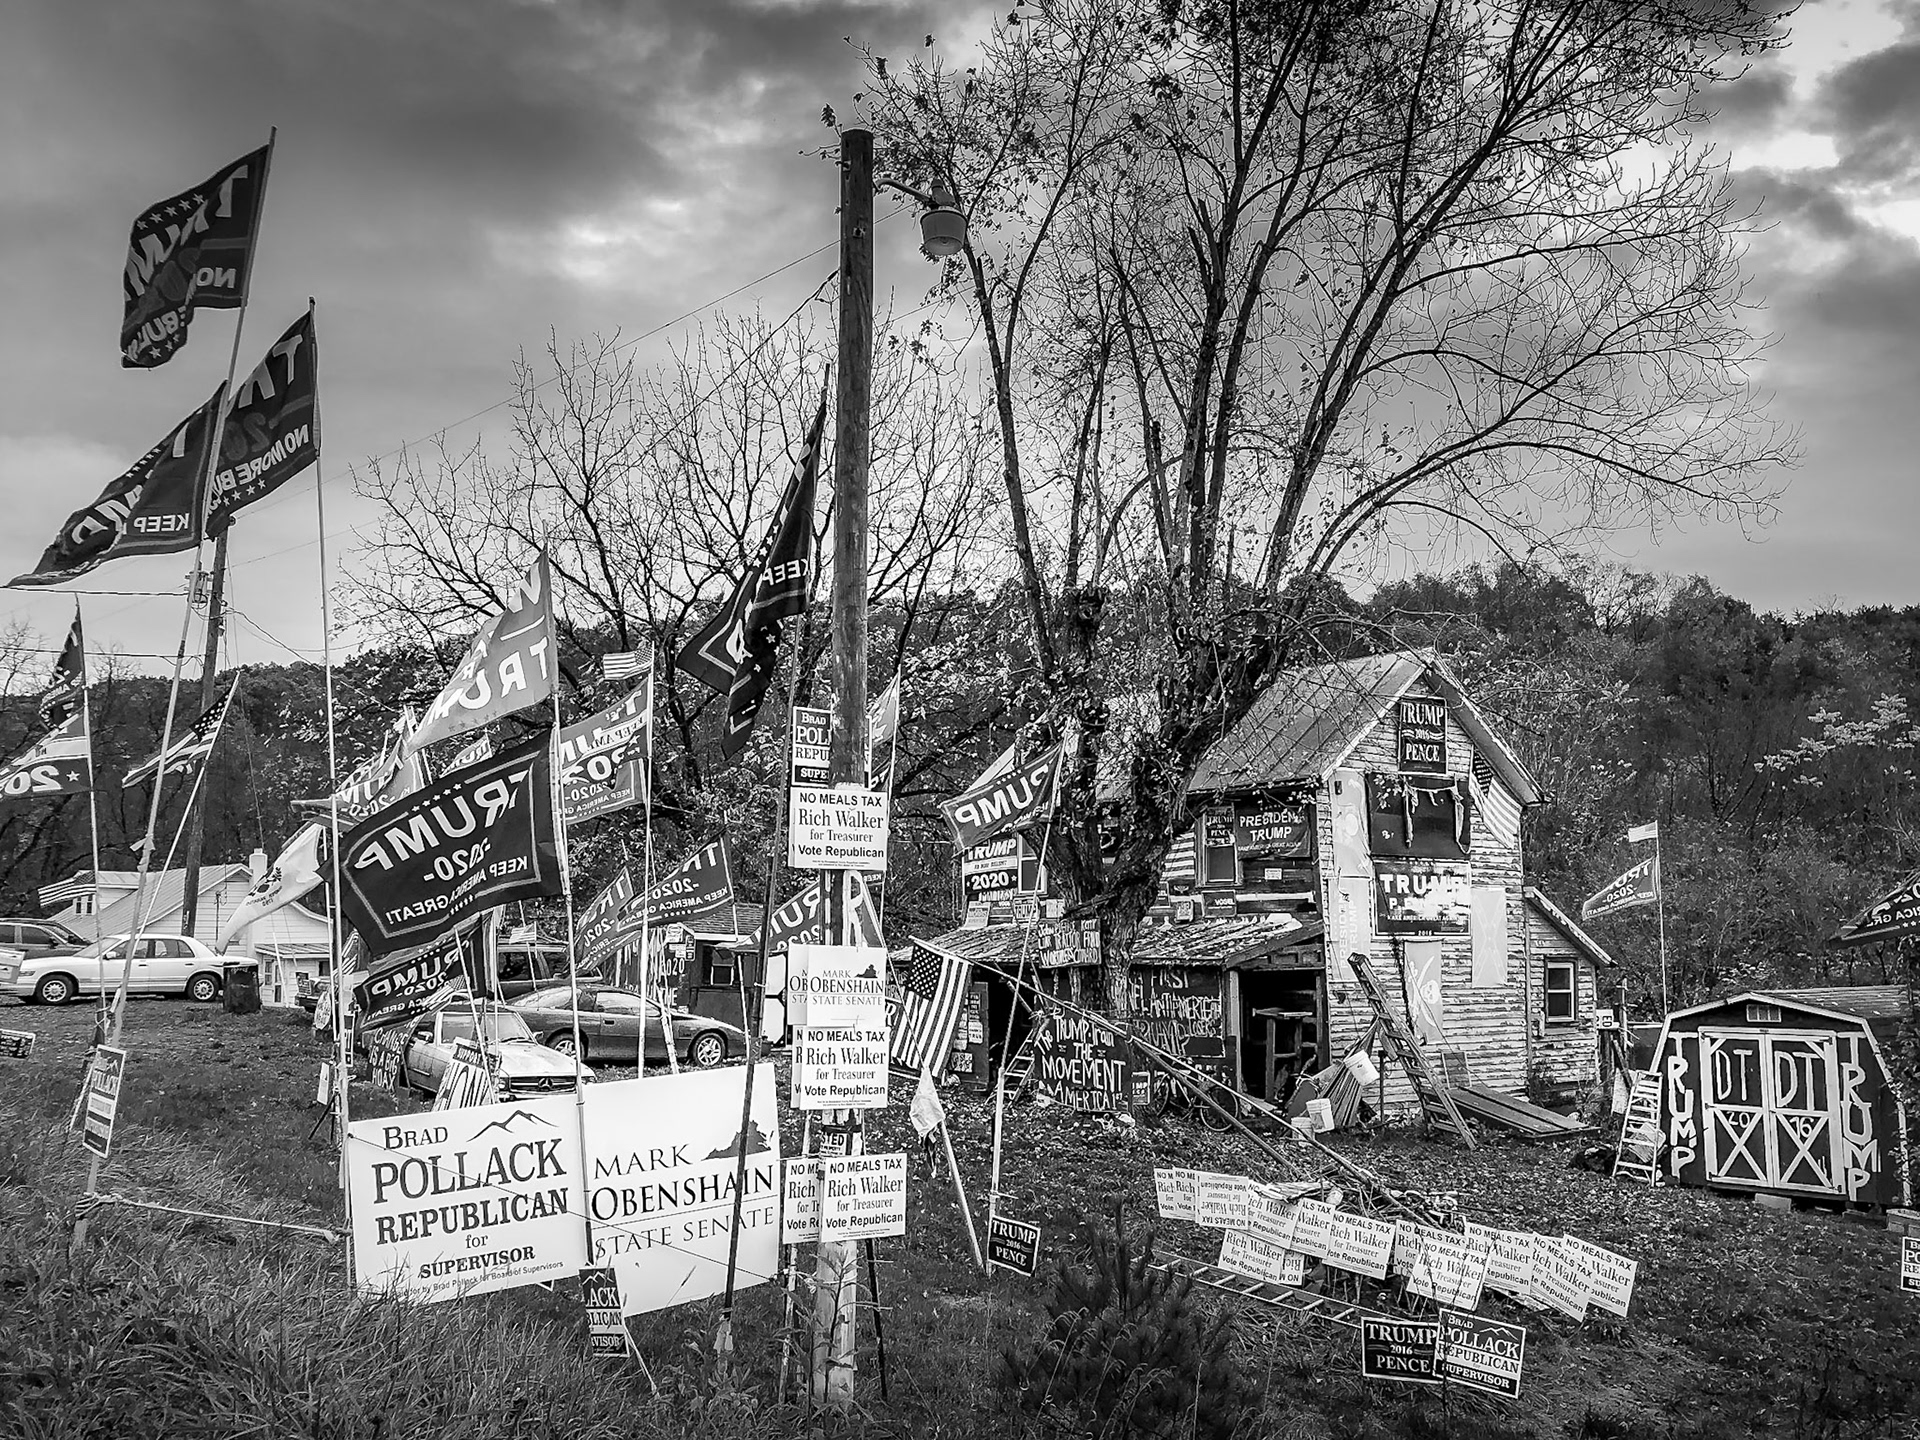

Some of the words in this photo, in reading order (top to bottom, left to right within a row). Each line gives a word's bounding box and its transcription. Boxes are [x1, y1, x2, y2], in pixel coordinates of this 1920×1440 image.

[1402, 702, 1444, 726] TRUMP
[1405, 743, 1440, 761] PENCE
[799, 793, 816, 803] NO
[819, 794, 858, 806] MEALS
[861, 796, 882, 807] TAX
[799, 808, 831, 826] Rich
[835, 810, 884, 828] Walker
[810, 829, 824, 840] for
[827, 830, 873, 842] Treasurer
[1250, 827, 1292, 841] TRUMP
[799, 845, 821, 855] Vote
[825, 846, 884, 858] Republican
[967, 838, 1017, 861] TRUMP
[971, 871, 1009, 890] 2020
[823, 970, 851, 979] MARK
[810, 976, 884, 994] OBENSHAIN
[813, 995, 841, 1005] STATE
[845, 995, 883, 1005] SENATE
[808, 1031, 823, 1042] NO
[827, 1031, 862, 1042] MEALS
[865, 1031, 885, 1042] TAX
[369, 1045, 379, 1067] IS
[378, 1051, 385, 1067] A
[384, 1052, 399, 1075] BIG
[806, 1047, 836, 1065] Rich
[841, 1047, 886, 1065] Walker
[1073, 1042, 1094, 1061] THE
[372, 1067, 396, 1093] HOAX
[816, 1067, 830, 1080] for
[833, 1068, 876, 1080] Treasurer
[1041, 1055, 1126, 1092] MOVEMENT
[1715, 1050, 1753, 1101] DT
[1775, 1051, 1821, 1112] DT
[805, 1083, 827, 1096] Vote
[831, 1083, 886, 1099] Republican
[1054, 1080, 1110, 1111] AMERICA
[1668, 1032, 1698, 1180] TRUMP
[1725, 1112, 1750, 1128] 20
[1836, 1032, 1881, 1202] TRUMP
[371, 1138, 567, 1204] POLLACK
[593, 1143, 693, 1180] MARK
[790, 1163, 805, 1175] NO
[830, 1163, 845, 1174] NO
[847, 1159, 881, 1172] MEALS
[884, 1158, 902, 1170] TAX
[592, 1164, 774, 1221] OBENSHAIN
[788, 1180, 815, 1198] Rich
[828, 1178, 856, 1197] Rich
[860, 1175, 903, 1194] Walker
[797, 1200, 808, 1213] for
[837, 1200, 850, 1212] for
[853, 1198, 894, 1211] Treasurer
[1265, 1201, 1297, 1221] Walker
[1317, 1204, 1331, 1215] TAX
[375, 1187, 569, 1246] REPUBLICAN
[787, 1218, 806, 1229] Vote
[826, 1218, 847, 1228] Vote
[850, 1213, 903, 1227] Republican
[1333, 1213, 1345, 1223] NO
[1346, 1216, 1373, 1231] MEALS
[1375, 1222, 1392, 1235] TAX
[992, 1220, 1036, 1244] TRUMP
[1253, 1220, 1290, 1241] Republican
[1330, 1224, 1351, 1241] Rich
[1355, 1230, 1389, 1250] Walker
[1400, 1223, 1412, 1232] NO
[1445, 1234, 1461, 1246] TAX
[1469, 1226, 1482, 1236] NO
[1483, 1229, 1512, 1244] MEALS
[1514, 1236, 1530, 1248] TAX
[465, 1233, 489, 1249] for
[595, 1226, 673, 1259] STATE
[1006, 1239, 1020, 1249] 2016
[1227, 1231, 1246, 1249] Rich
[1250, 1240, 1281, 1261] Walker
[1345, 1242, 1379, 1258] Treasurer
[1398, 1233, 1421, 1250] Rich
[417, 1246, 536, 1280] SUPERVISOR
[996, 1246, 1027, 1266] PENCE
[1242, 1250, 1273, 1268] Treasurer
[1342, 1252, 1385, 1271] Republican
[1470, 1252, 1486, 1266] TAX
[1533, 1236, 1546, 1248] NO
[1547, 1245, 1575, 1267] MEALS
[1577, 1262, 1593, 1279] TAX
[1566, 1238, 1580, 1250] NO
[1581, 1244, 1612, 1264] MEALS
[1614, 1257, 1632, 1272] TAX
[433, 1280, 450, 1291] Brad
[522, 1261, 564, 1275] Supervisors
[1222, 1254, 1237, 1266] Vote
[1239, 1259, 1277, 1281] Republican
[1446, 1257, 1482, 1281] Walker
[1592, 1260, 1631, 1287] Walker
[1545, 1271, 1579, 1298] Treasurer
[1555, 1262, 1590, 1294] Walker
[1540, 1280, 1584, 1313] Republican
[1366, 1322, 1437, 1345] TRUMP
[1440, 1324, 1520, 1360] POLLACK
[1390, 1344, 1413, 1355] 2016
[1376, 1354, 1431, 1374] PENCE
